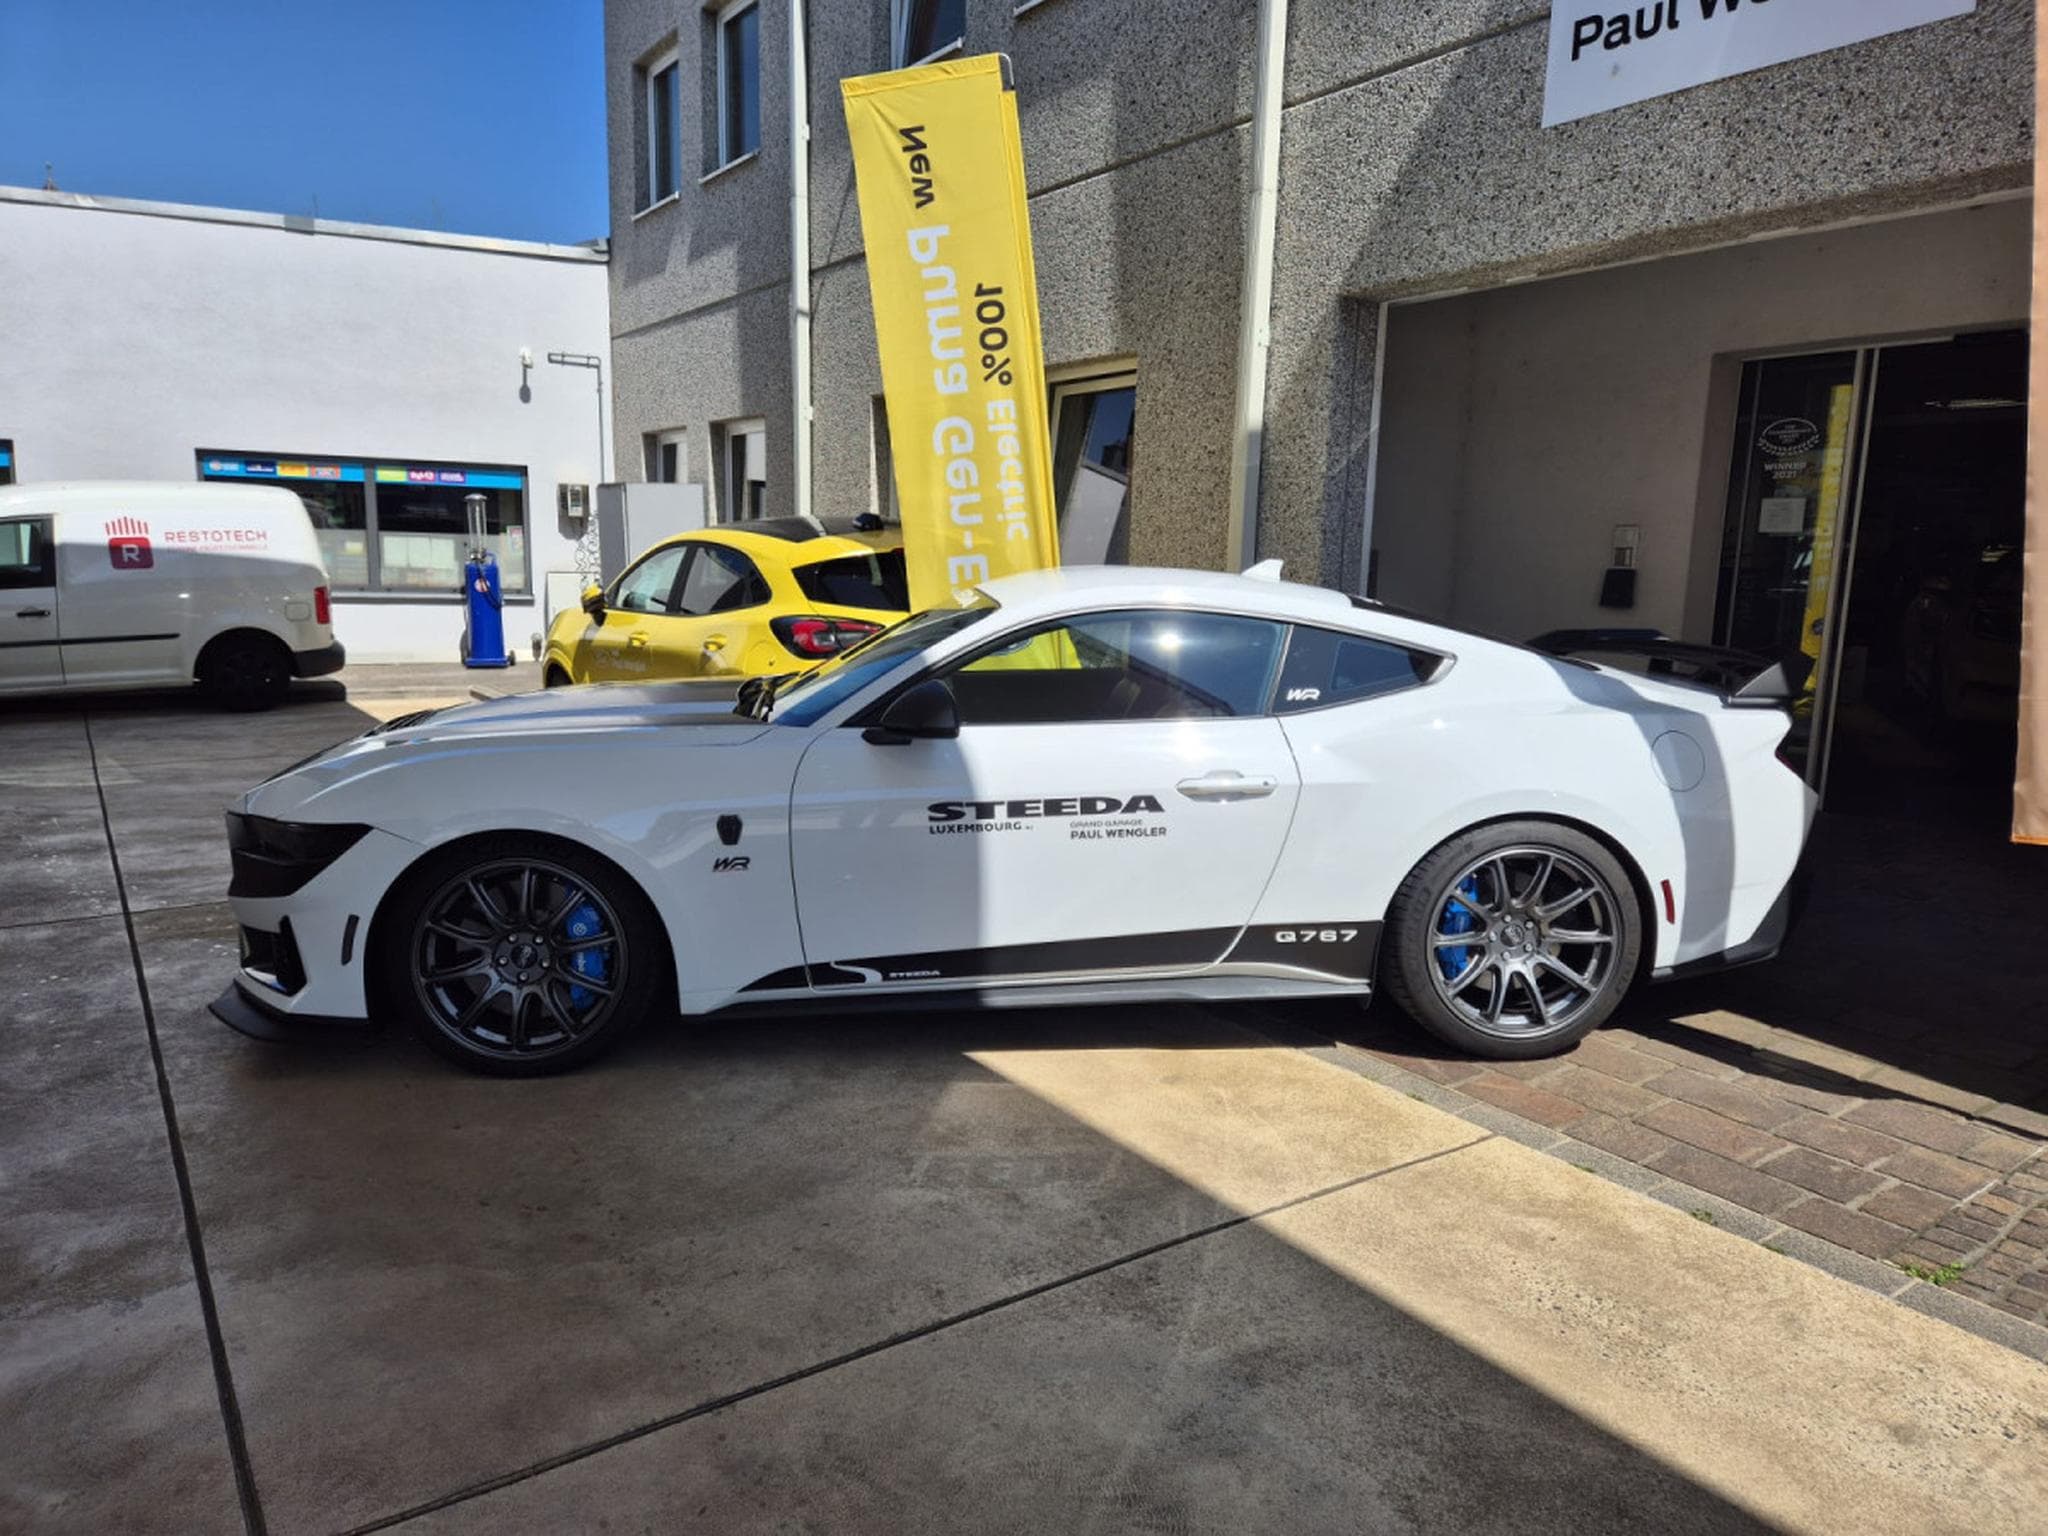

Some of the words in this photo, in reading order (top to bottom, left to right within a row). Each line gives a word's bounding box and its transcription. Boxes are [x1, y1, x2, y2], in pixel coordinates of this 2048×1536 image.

[1571, 0, 1680, 61] Paul
[164, 530, 268, 543] RESTOTECH
[121, 544, 141, 562] R
[928, 795, 1165, 822] STEEDA
[929, 822, 1022, 835] LUXEMBOURG
[1069, 820, 1103, 829] GRAND
[1070, 829, 1104, 840] PAUL
[1105, 827, 1167, 839] WENGLER
[1275, 929, 1358, 943] Q767
